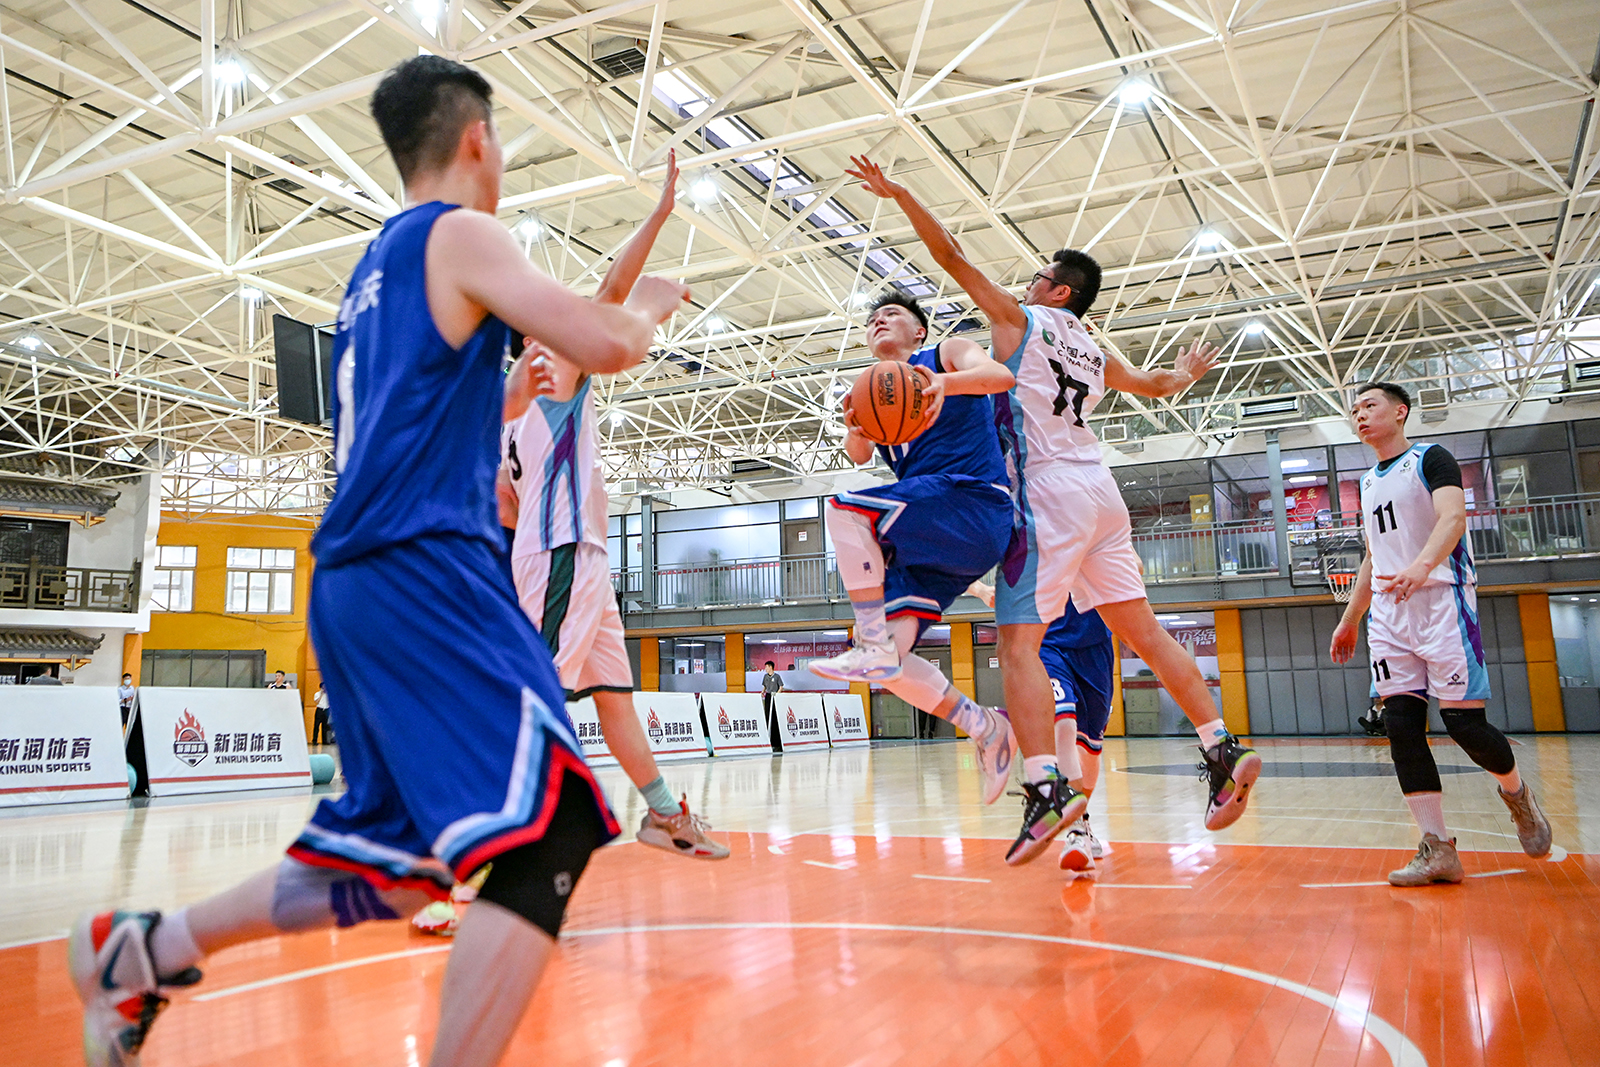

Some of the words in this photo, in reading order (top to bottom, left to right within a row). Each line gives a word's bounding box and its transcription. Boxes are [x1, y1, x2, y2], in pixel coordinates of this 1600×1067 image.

[1057, 349, 1081, 368] CINA
[1083, 363, 1101, 377] LIFE
[1372, 500, 1398, 534] 11
[1372, 658, 1391, 682] 11
[664, 722, 693, 735] 新润体育
[0, 738, 91, 762] 新润体育
[214, 733, 282, 753] 新润体育
[46, 762, 91, 773] SPORTS
[214, 755, 248, 764] XINRUN
[250, 755, 283, 763] SPORTS
